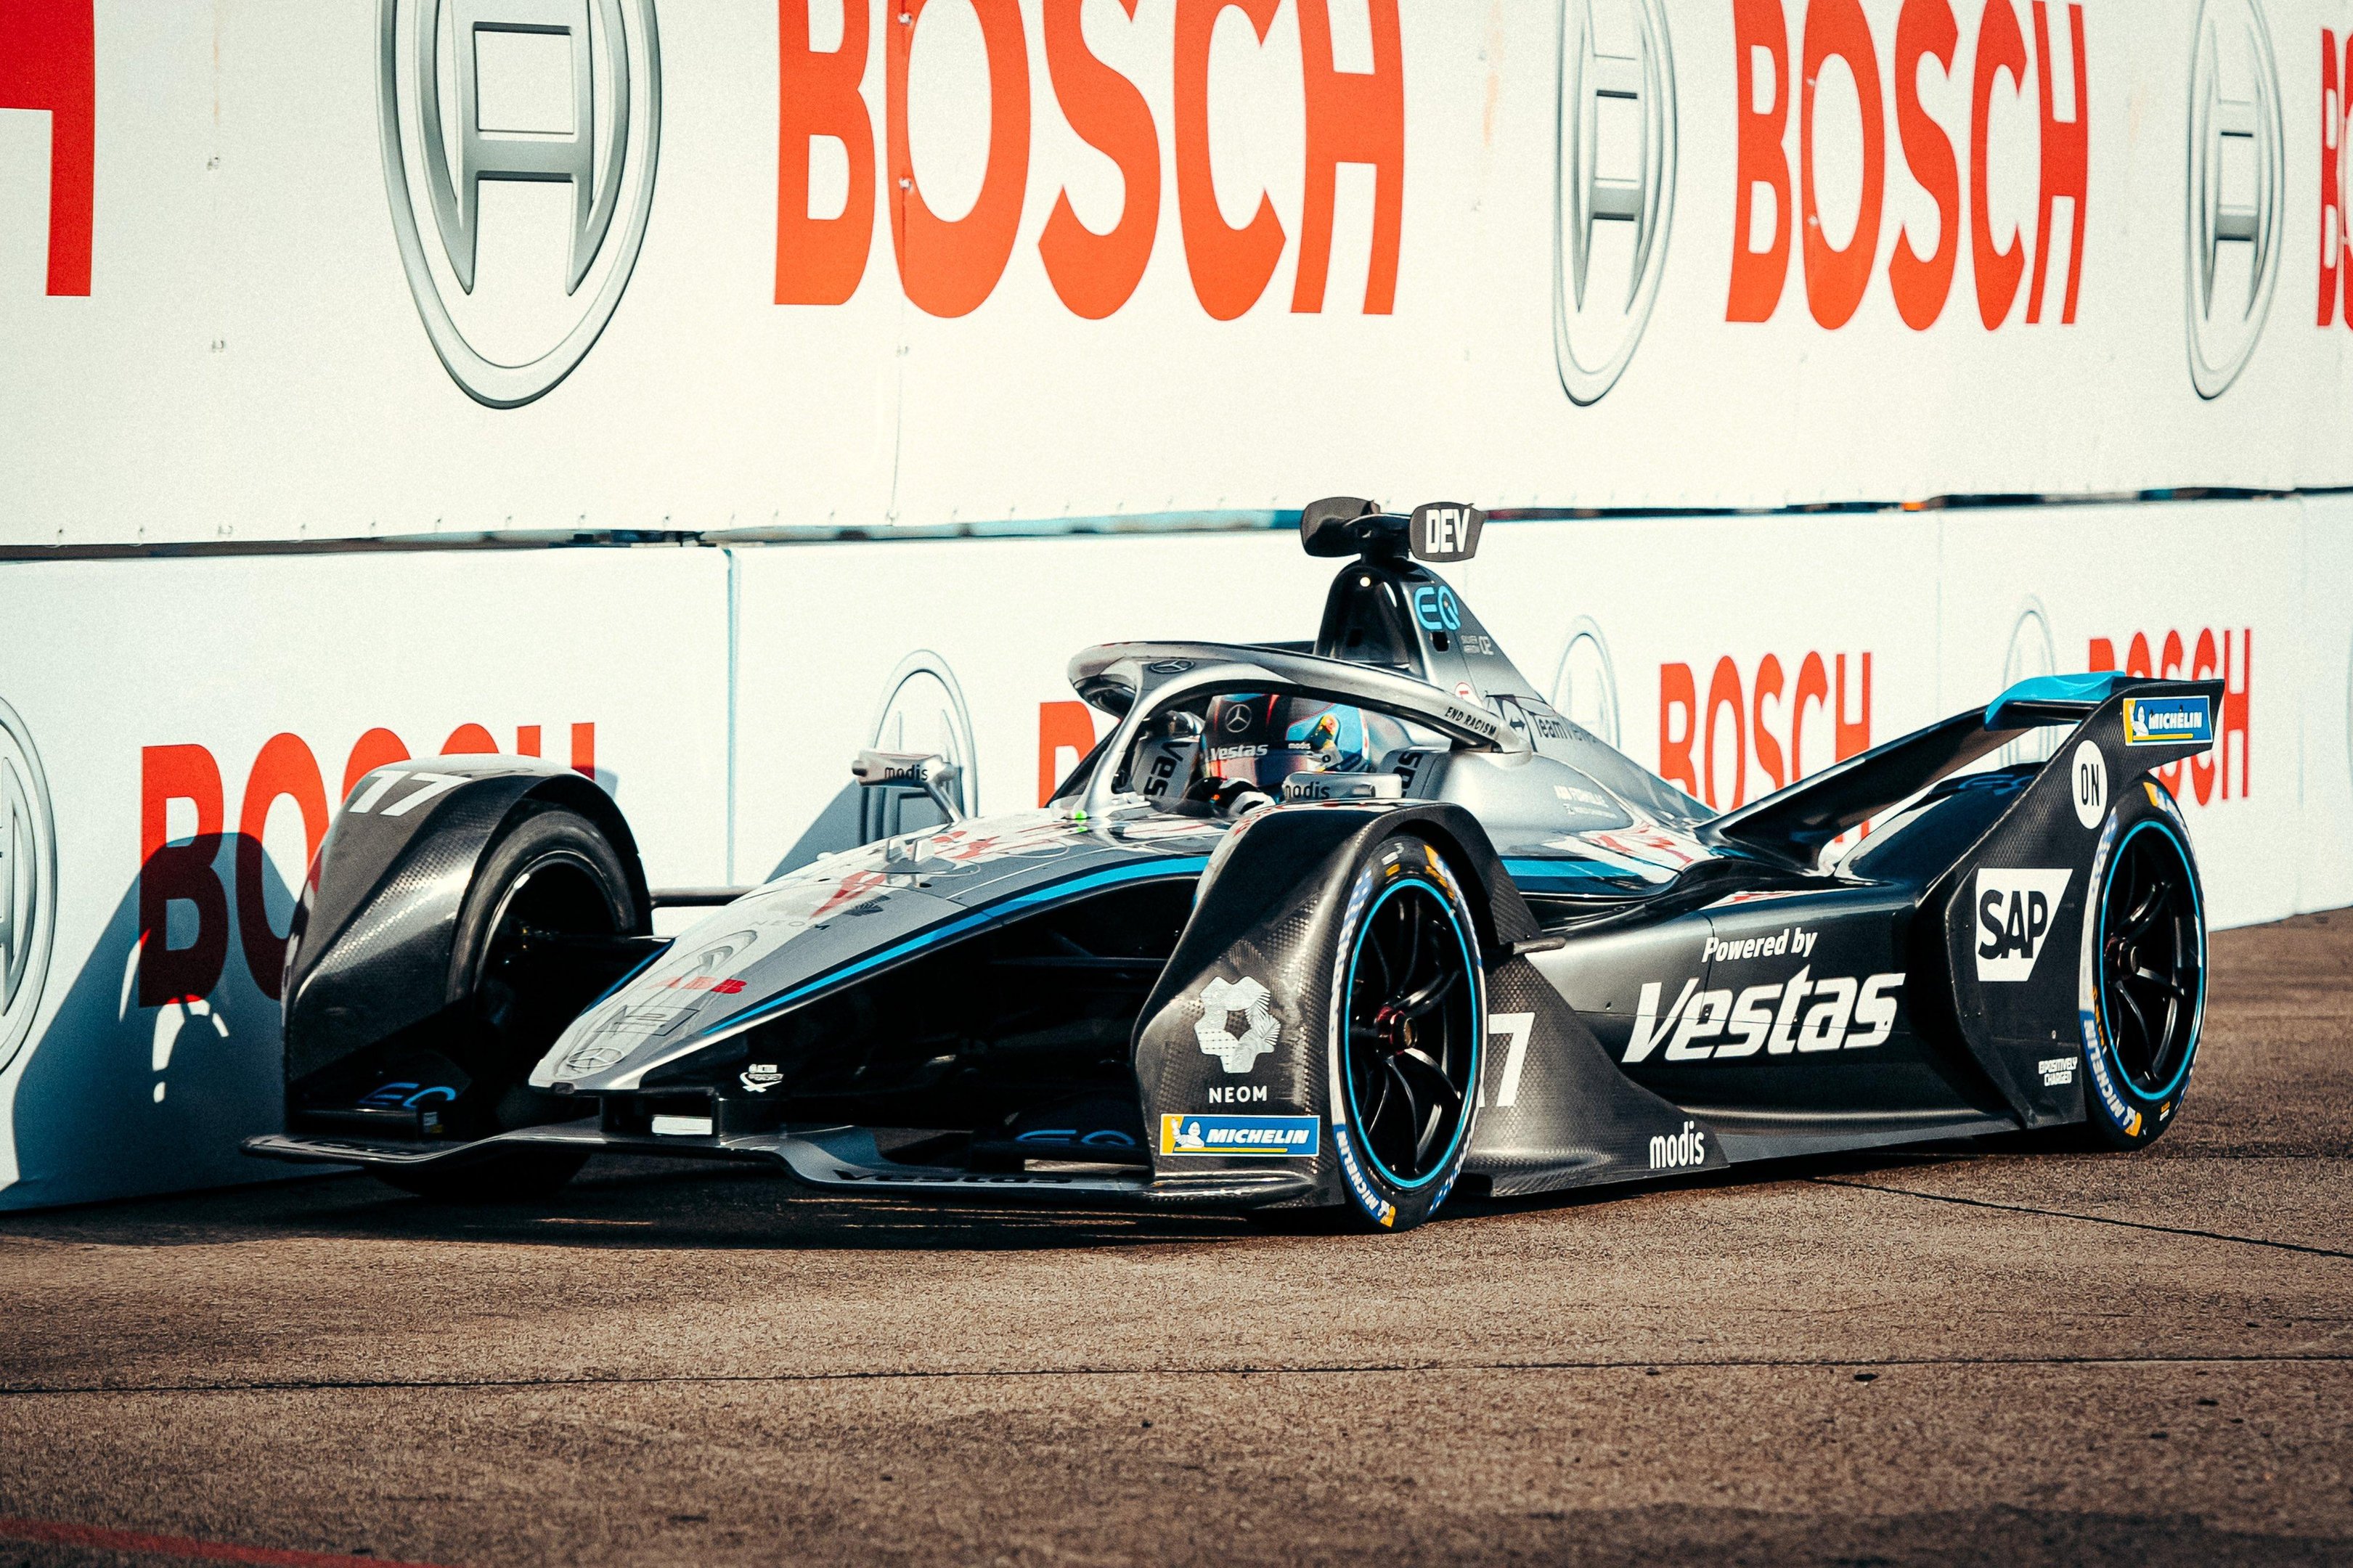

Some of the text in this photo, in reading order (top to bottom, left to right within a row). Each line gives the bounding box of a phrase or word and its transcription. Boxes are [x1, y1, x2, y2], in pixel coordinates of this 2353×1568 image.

[773, 0, 1404, 321] BOSCH
[1726, 0, 2089, 330] BOSCH
[1425, 508, 1470, 554] DEV
[1414, 586, 1461, 630] EQ
[1445, 706, 1497, 737] END RACISM
[2148, 711, 2203, 730] MICHELIN
[884, 764, 929, 782] modis
[1210, 744, 1269, 761] Vestas
[348, 770, 472, 817] 17
[2081, 763, 2100, 807] ON
[1702, 927, 1817, 963] Powered by
[1978, 889, 2048, 959] SAP
[1621, 964, 1906, 1062] Vestas
[1479, 1012, 1536, 1107] 7
[2084, 1019, 2126, 1118] MICHELIN
[1209, 1086, 1268, 1103] NEOM
[1206, 1129, 1310, 1144] MICHELIN
[1649, 1120, 1705, 1169] modis
[1336, 1130, 1379, 1211] MICHELIN
